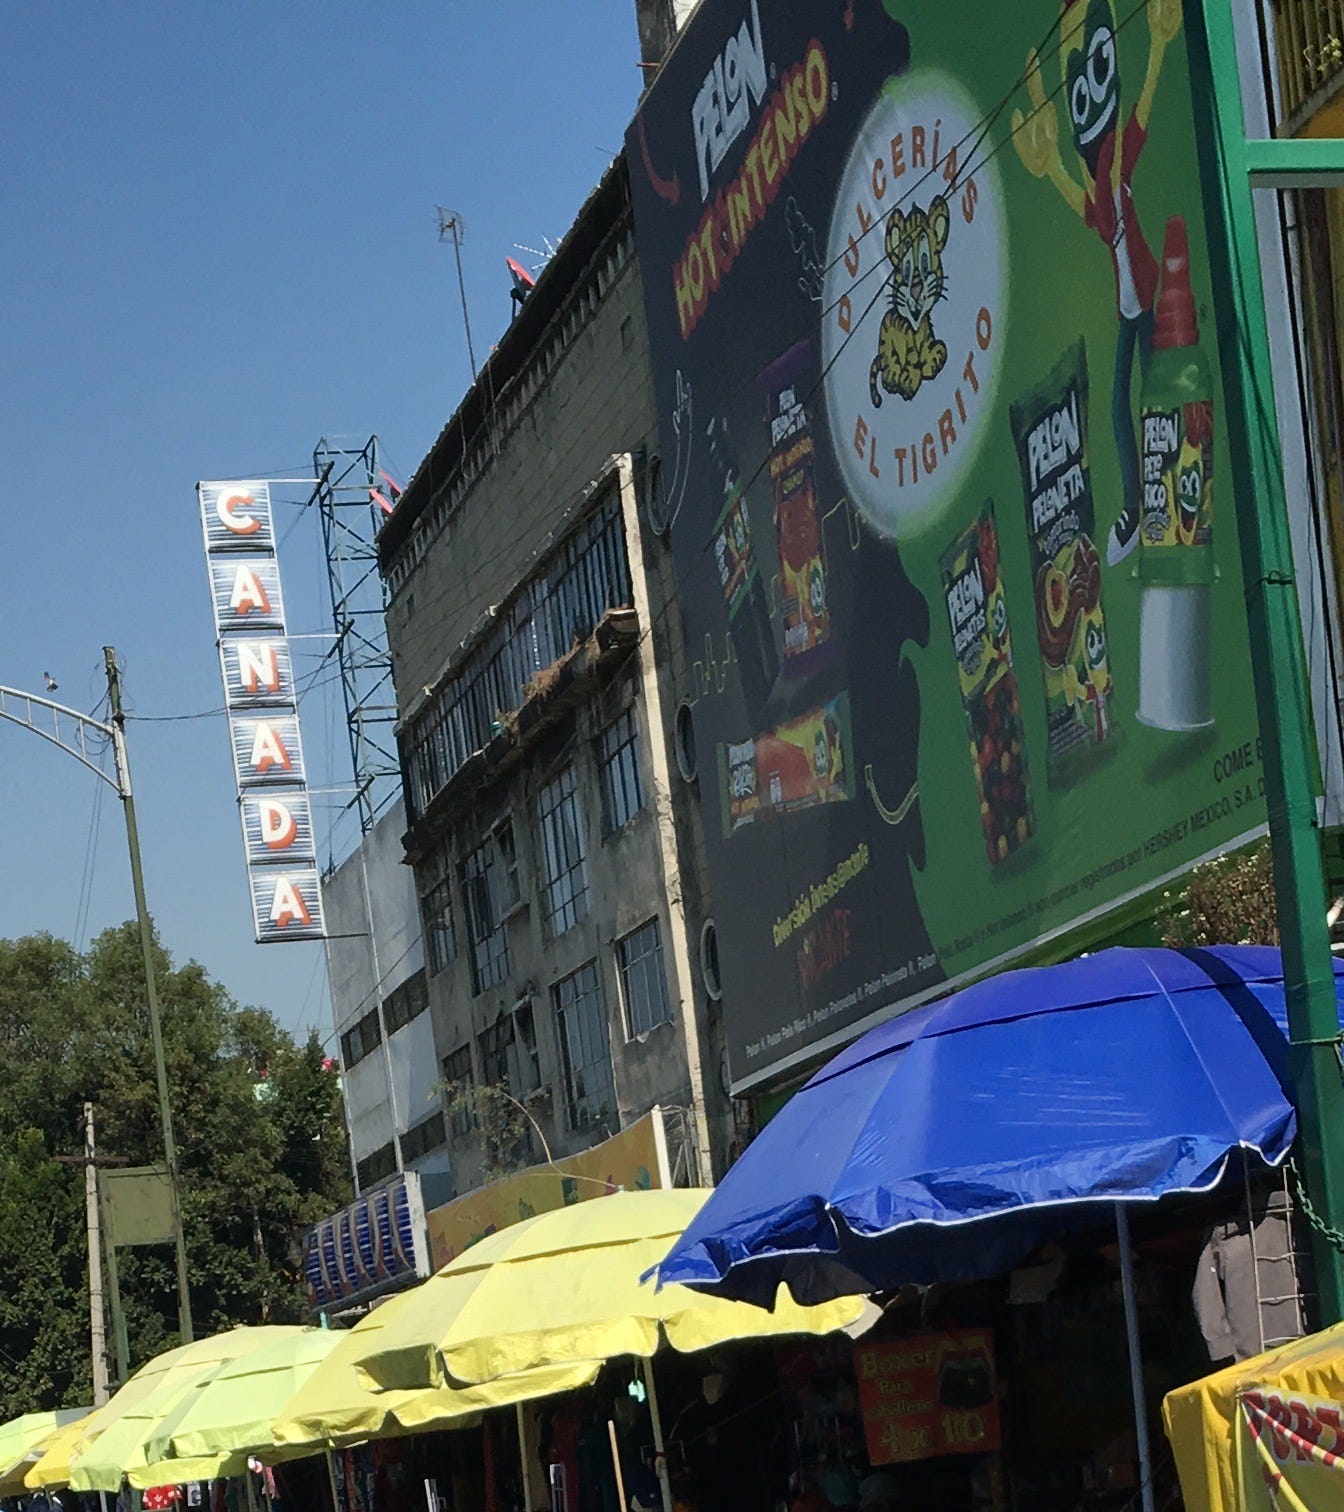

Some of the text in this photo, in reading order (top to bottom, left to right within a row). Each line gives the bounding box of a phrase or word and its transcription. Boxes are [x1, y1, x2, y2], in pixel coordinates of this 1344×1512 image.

[675, 48, 827, 333] HOT INTENSO
[854, 414, 880, 479] EL
[894, 305, 992, 487] TIGRITO
[1027, 390, 1081, 492] PELON
[1143, 413, 1178, 453] PELON
[947, 556, 984, 635] PELON
[215, 485, 312, 927] CANADA
[1213, 742, 1254, 783] COME
[1143, 815, 1190, 858] HERSHEY
